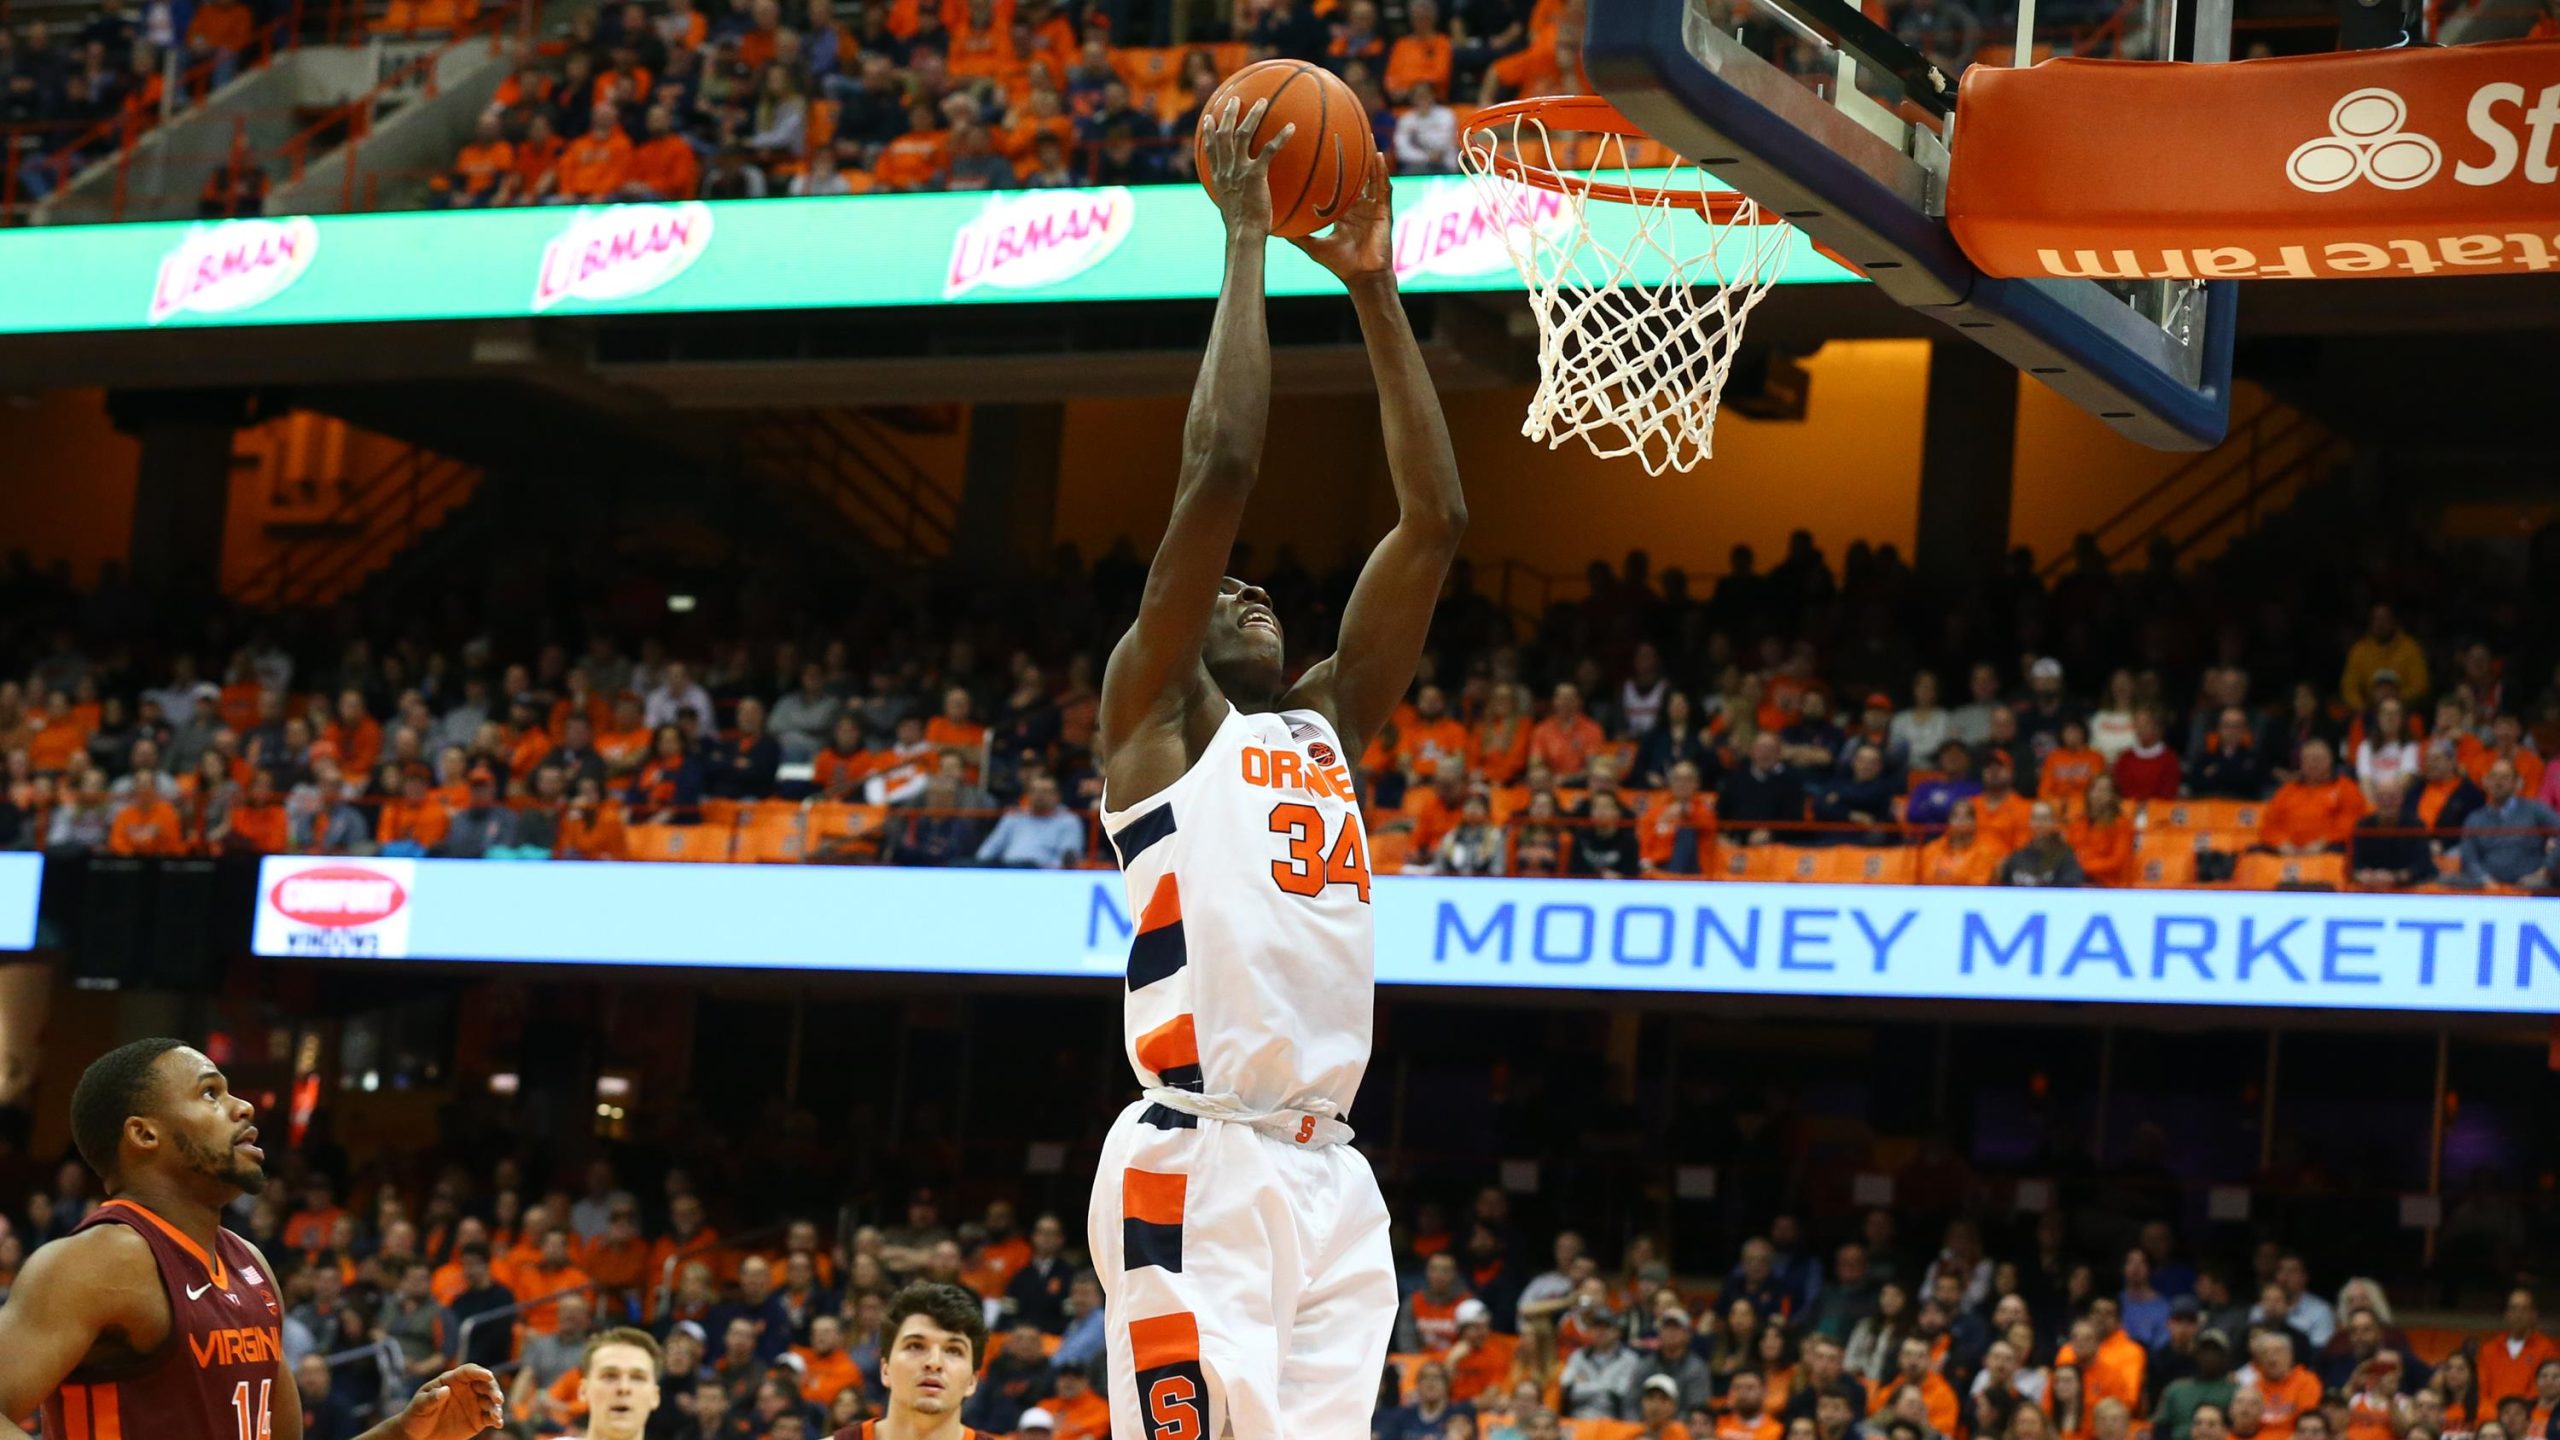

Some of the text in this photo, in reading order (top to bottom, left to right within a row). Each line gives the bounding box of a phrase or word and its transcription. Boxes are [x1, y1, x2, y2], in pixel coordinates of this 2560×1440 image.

[950, 199, 1115, 288] LIBMAN
[1268, 802, 1370, 904] 34
[1433, 900, 1920, 973] MOONEY
[1149, 1375, 1201, 1440] S
